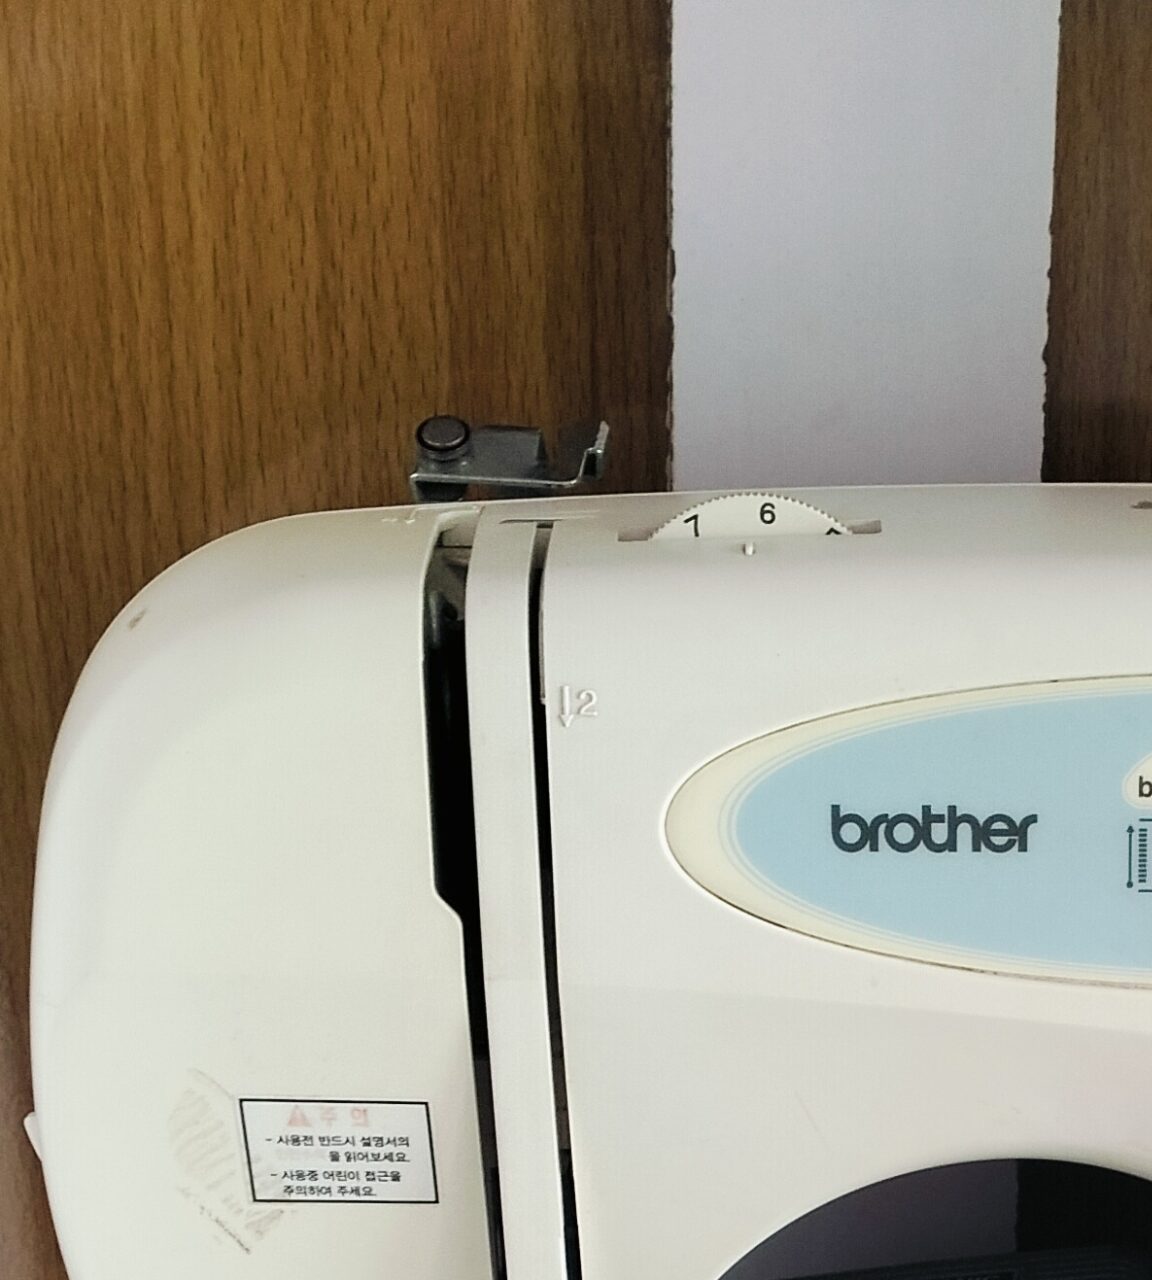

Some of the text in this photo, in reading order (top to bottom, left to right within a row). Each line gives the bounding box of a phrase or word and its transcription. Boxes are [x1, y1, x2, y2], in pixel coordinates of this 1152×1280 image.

[760, 503, 775, 524] 6
[576, 689, 599, 716] 2
[1139, 776, 1152, 797] b
[831, 805, 1037, 853] brother
[277, 1135, 314, 1146] 사용전
[319, 1136, 356, 1147] 반드시
[282, 1171, 319, 1182] 사용중
[323, 1171, 360, 1182] 어린이
[365, 1171, 401, 1183] 접근을
[283, 1186, 332, 1196] 주의하여
